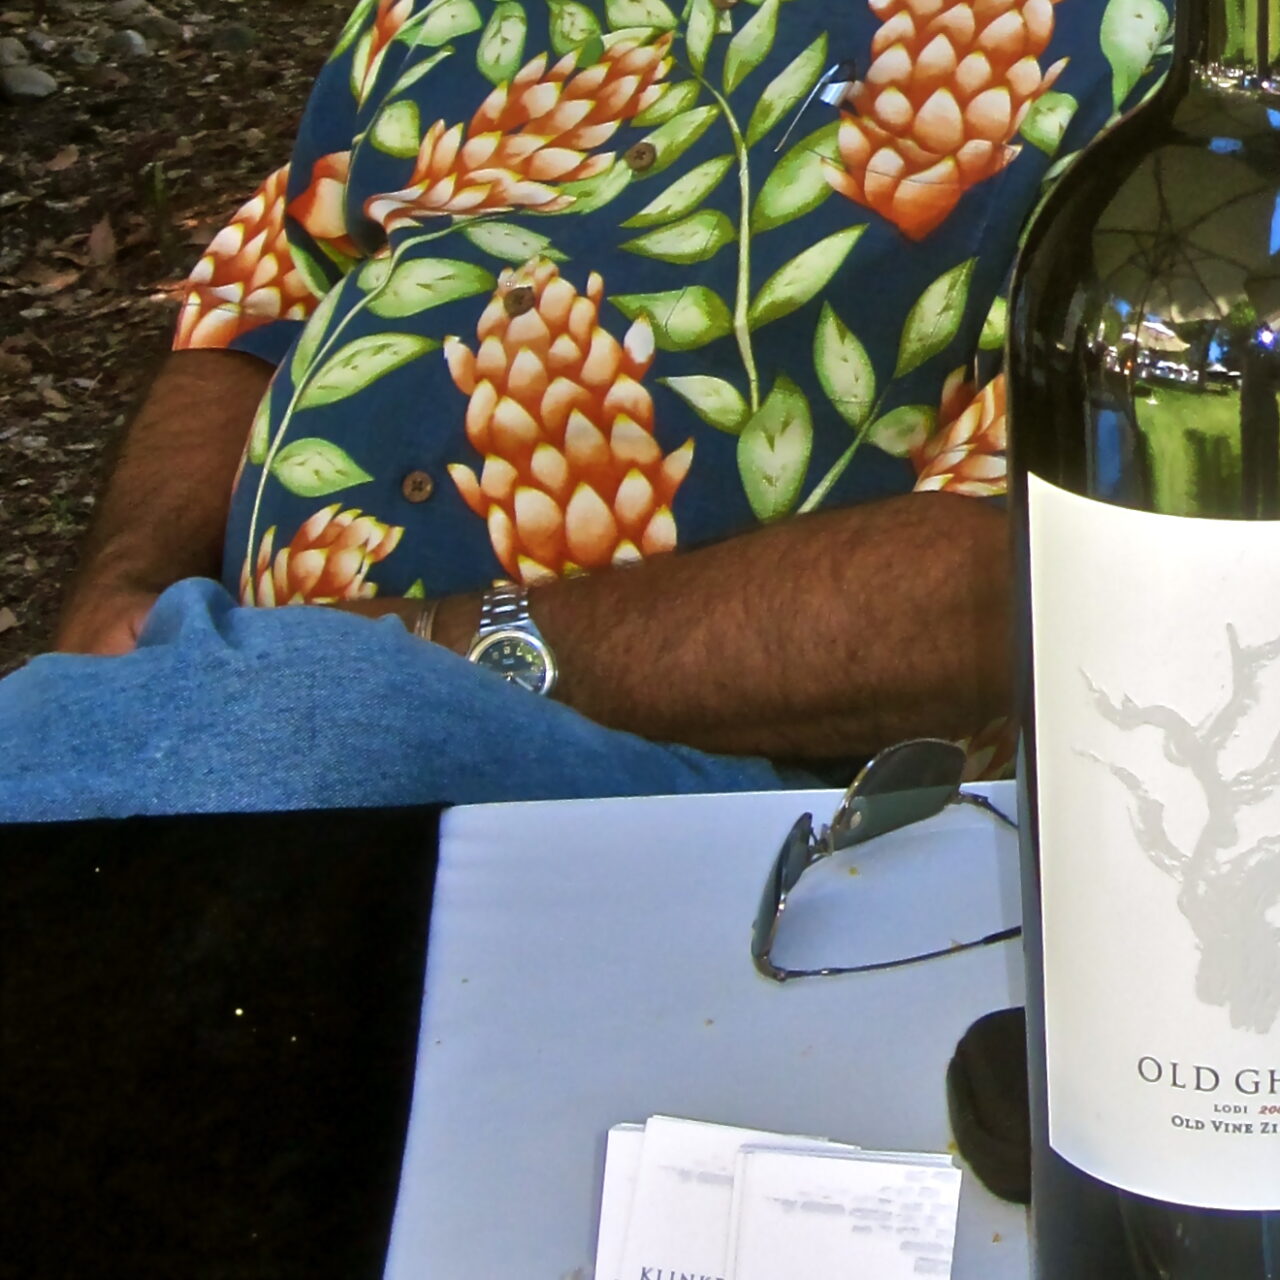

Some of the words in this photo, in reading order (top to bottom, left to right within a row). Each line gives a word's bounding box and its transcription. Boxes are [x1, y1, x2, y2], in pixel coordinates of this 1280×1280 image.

[1137, 1056, 1220, 1093] OLD
[1213, 1103, 1248, 1114] LODI
[1210, 1120, 1253, 1134] VINE
